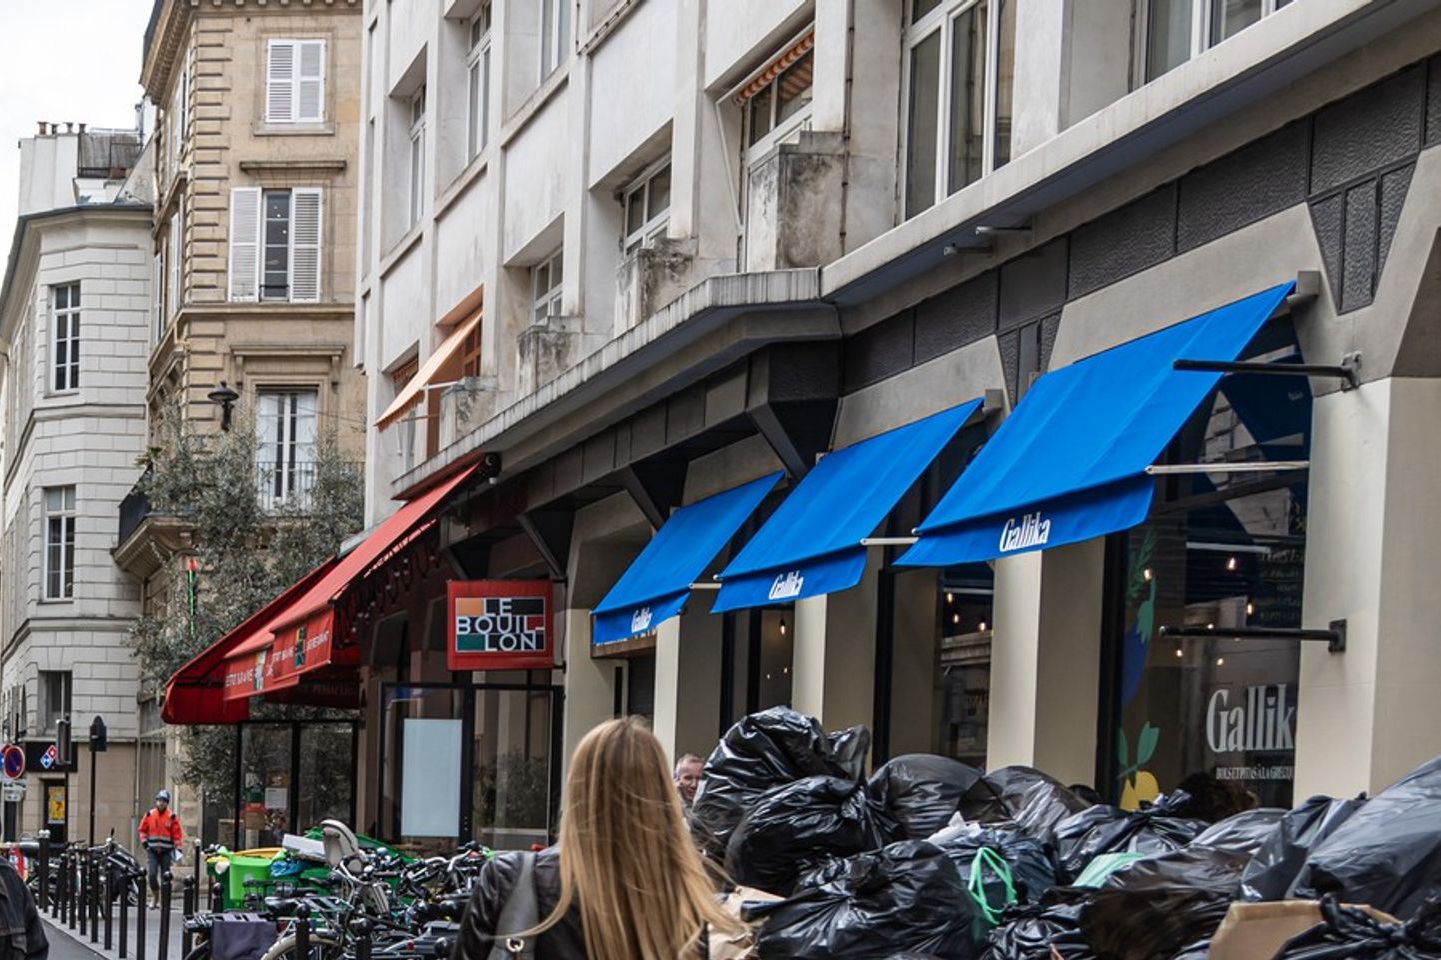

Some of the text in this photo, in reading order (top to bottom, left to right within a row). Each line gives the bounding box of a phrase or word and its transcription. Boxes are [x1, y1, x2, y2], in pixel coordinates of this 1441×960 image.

[999, 511, 1051, 553] Gallika
[483, 597, 512, 617] LE
[485, 633, 536, 651] LON
[1206, 684, 1295, 753] Gallik
